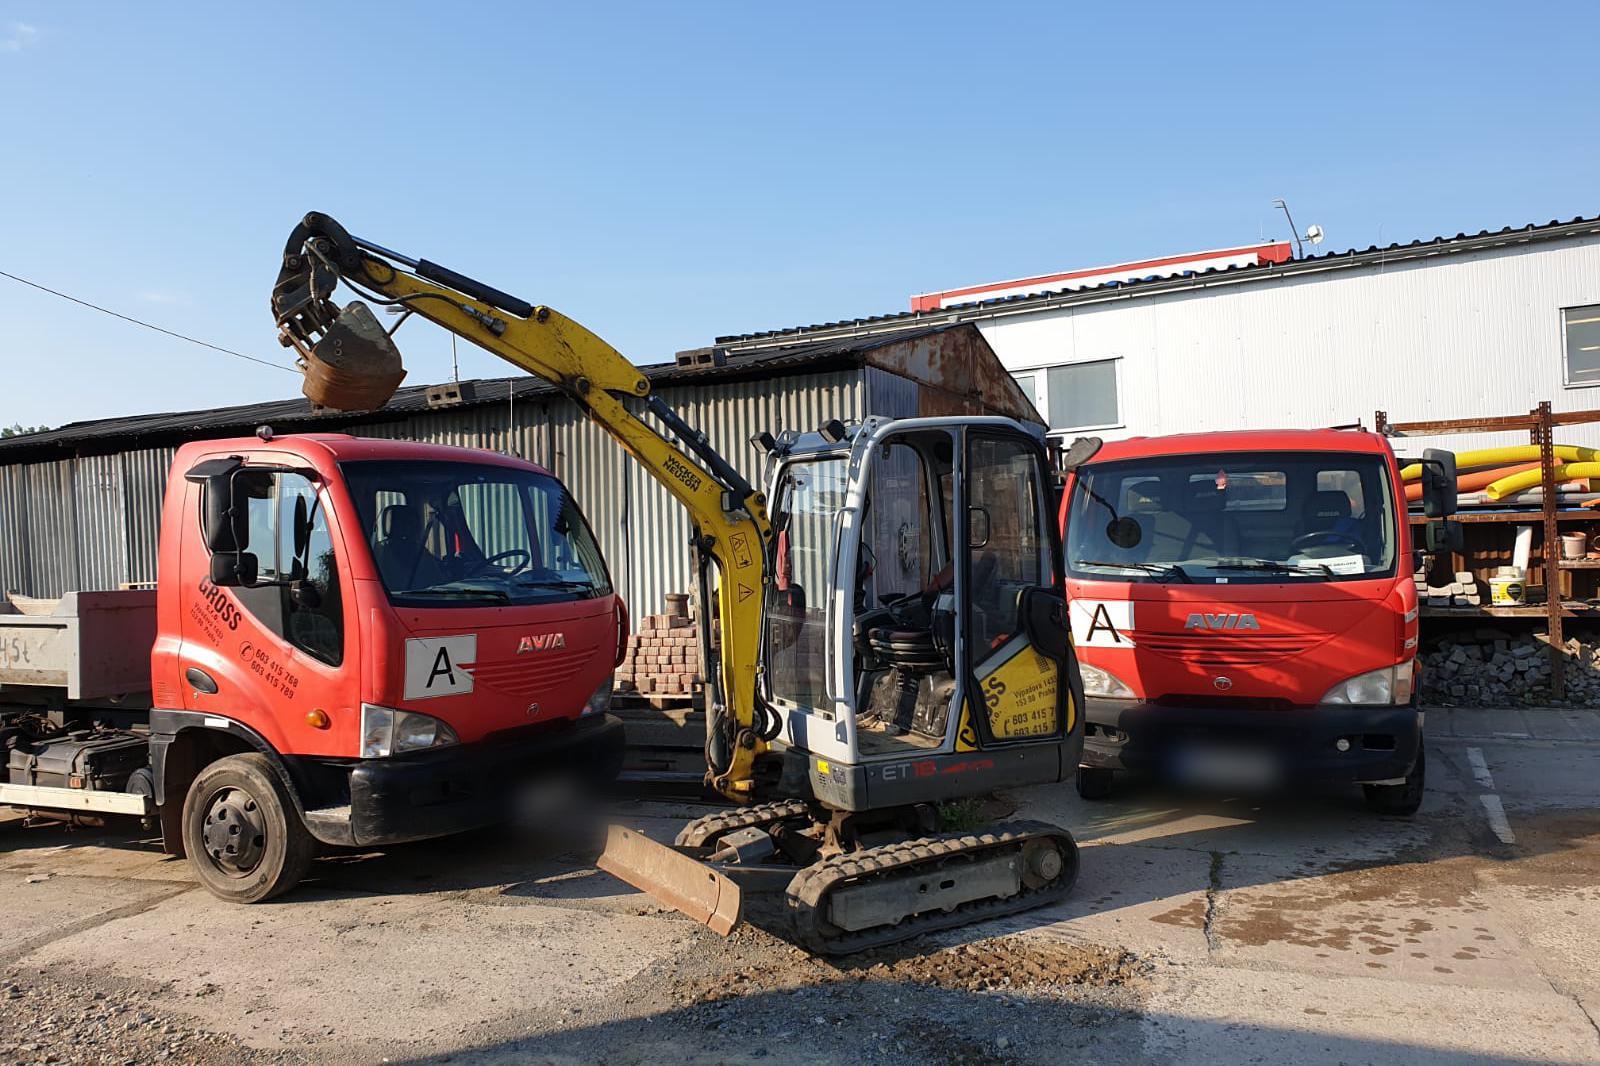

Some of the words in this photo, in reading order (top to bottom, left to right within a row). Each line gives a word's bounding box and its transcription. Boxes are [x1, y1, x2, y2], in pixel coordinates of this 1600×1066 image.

[662, 460, 701, 492] NEUSON
[668, 454, 702, 485] WACKER
[199, 574, 242, 631] GROSS
[1086, 603, 1121, 643] A
[1184, 613, 1261, 630] AVIA
[517, 633, 566, 655] AVIA
[255, 648, 270, 664] 603
[270, 661, 284, 676] 415
[425, 646, 456, 688] A
[251, 660, 265, 676] 603
[265, 672, 280, 688] 415
[280, 683, 294, 699] 789
[1012, 712, 1028, 725] 603
[1031, 708, 1047, 720] 415
[1032, 722, 1048, 734] 415
